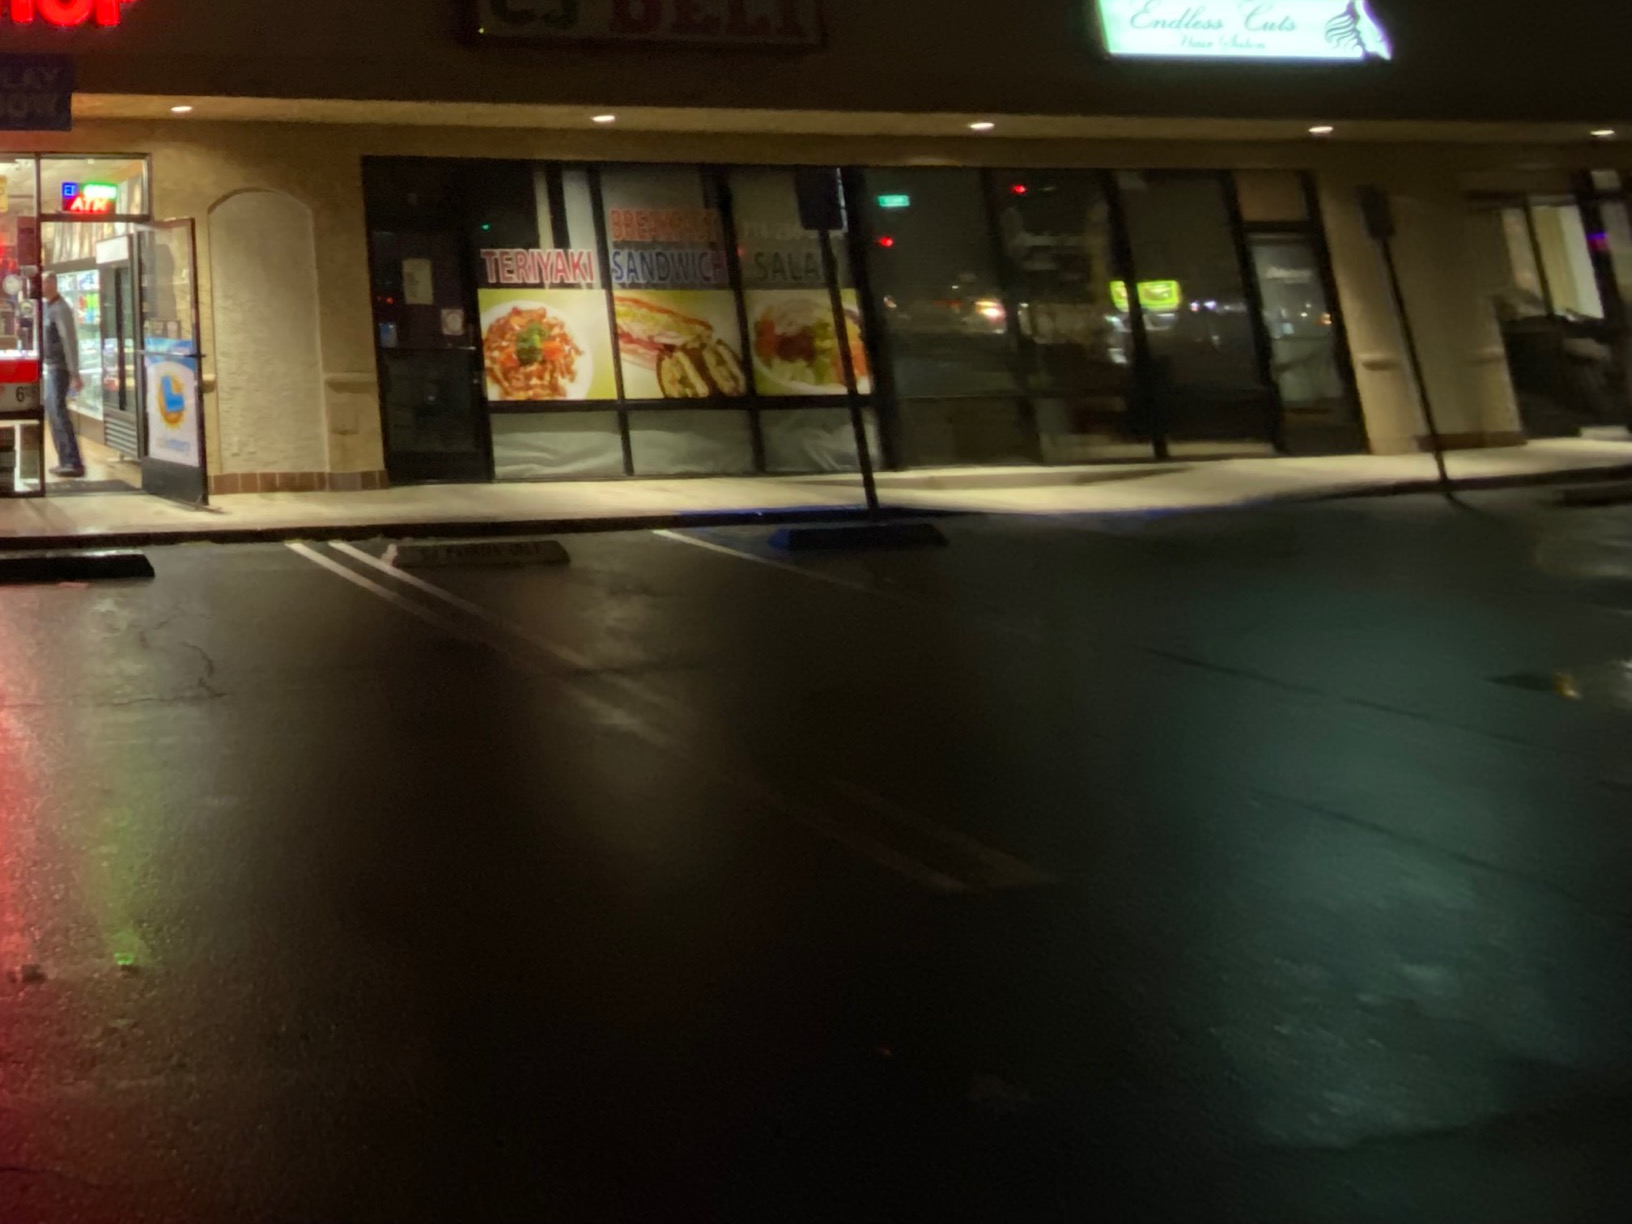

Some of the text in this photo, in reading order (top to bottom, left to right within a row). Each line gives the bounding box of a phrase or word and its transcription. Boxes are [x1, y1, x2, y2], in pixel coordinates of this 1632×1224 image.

[70, 196, 110, 211] ATM
[480, 248, 595, 284] TERIYAKI
[611, 249, 727, 282] SANDWICH
[754, 251, 824, 282] SALA
